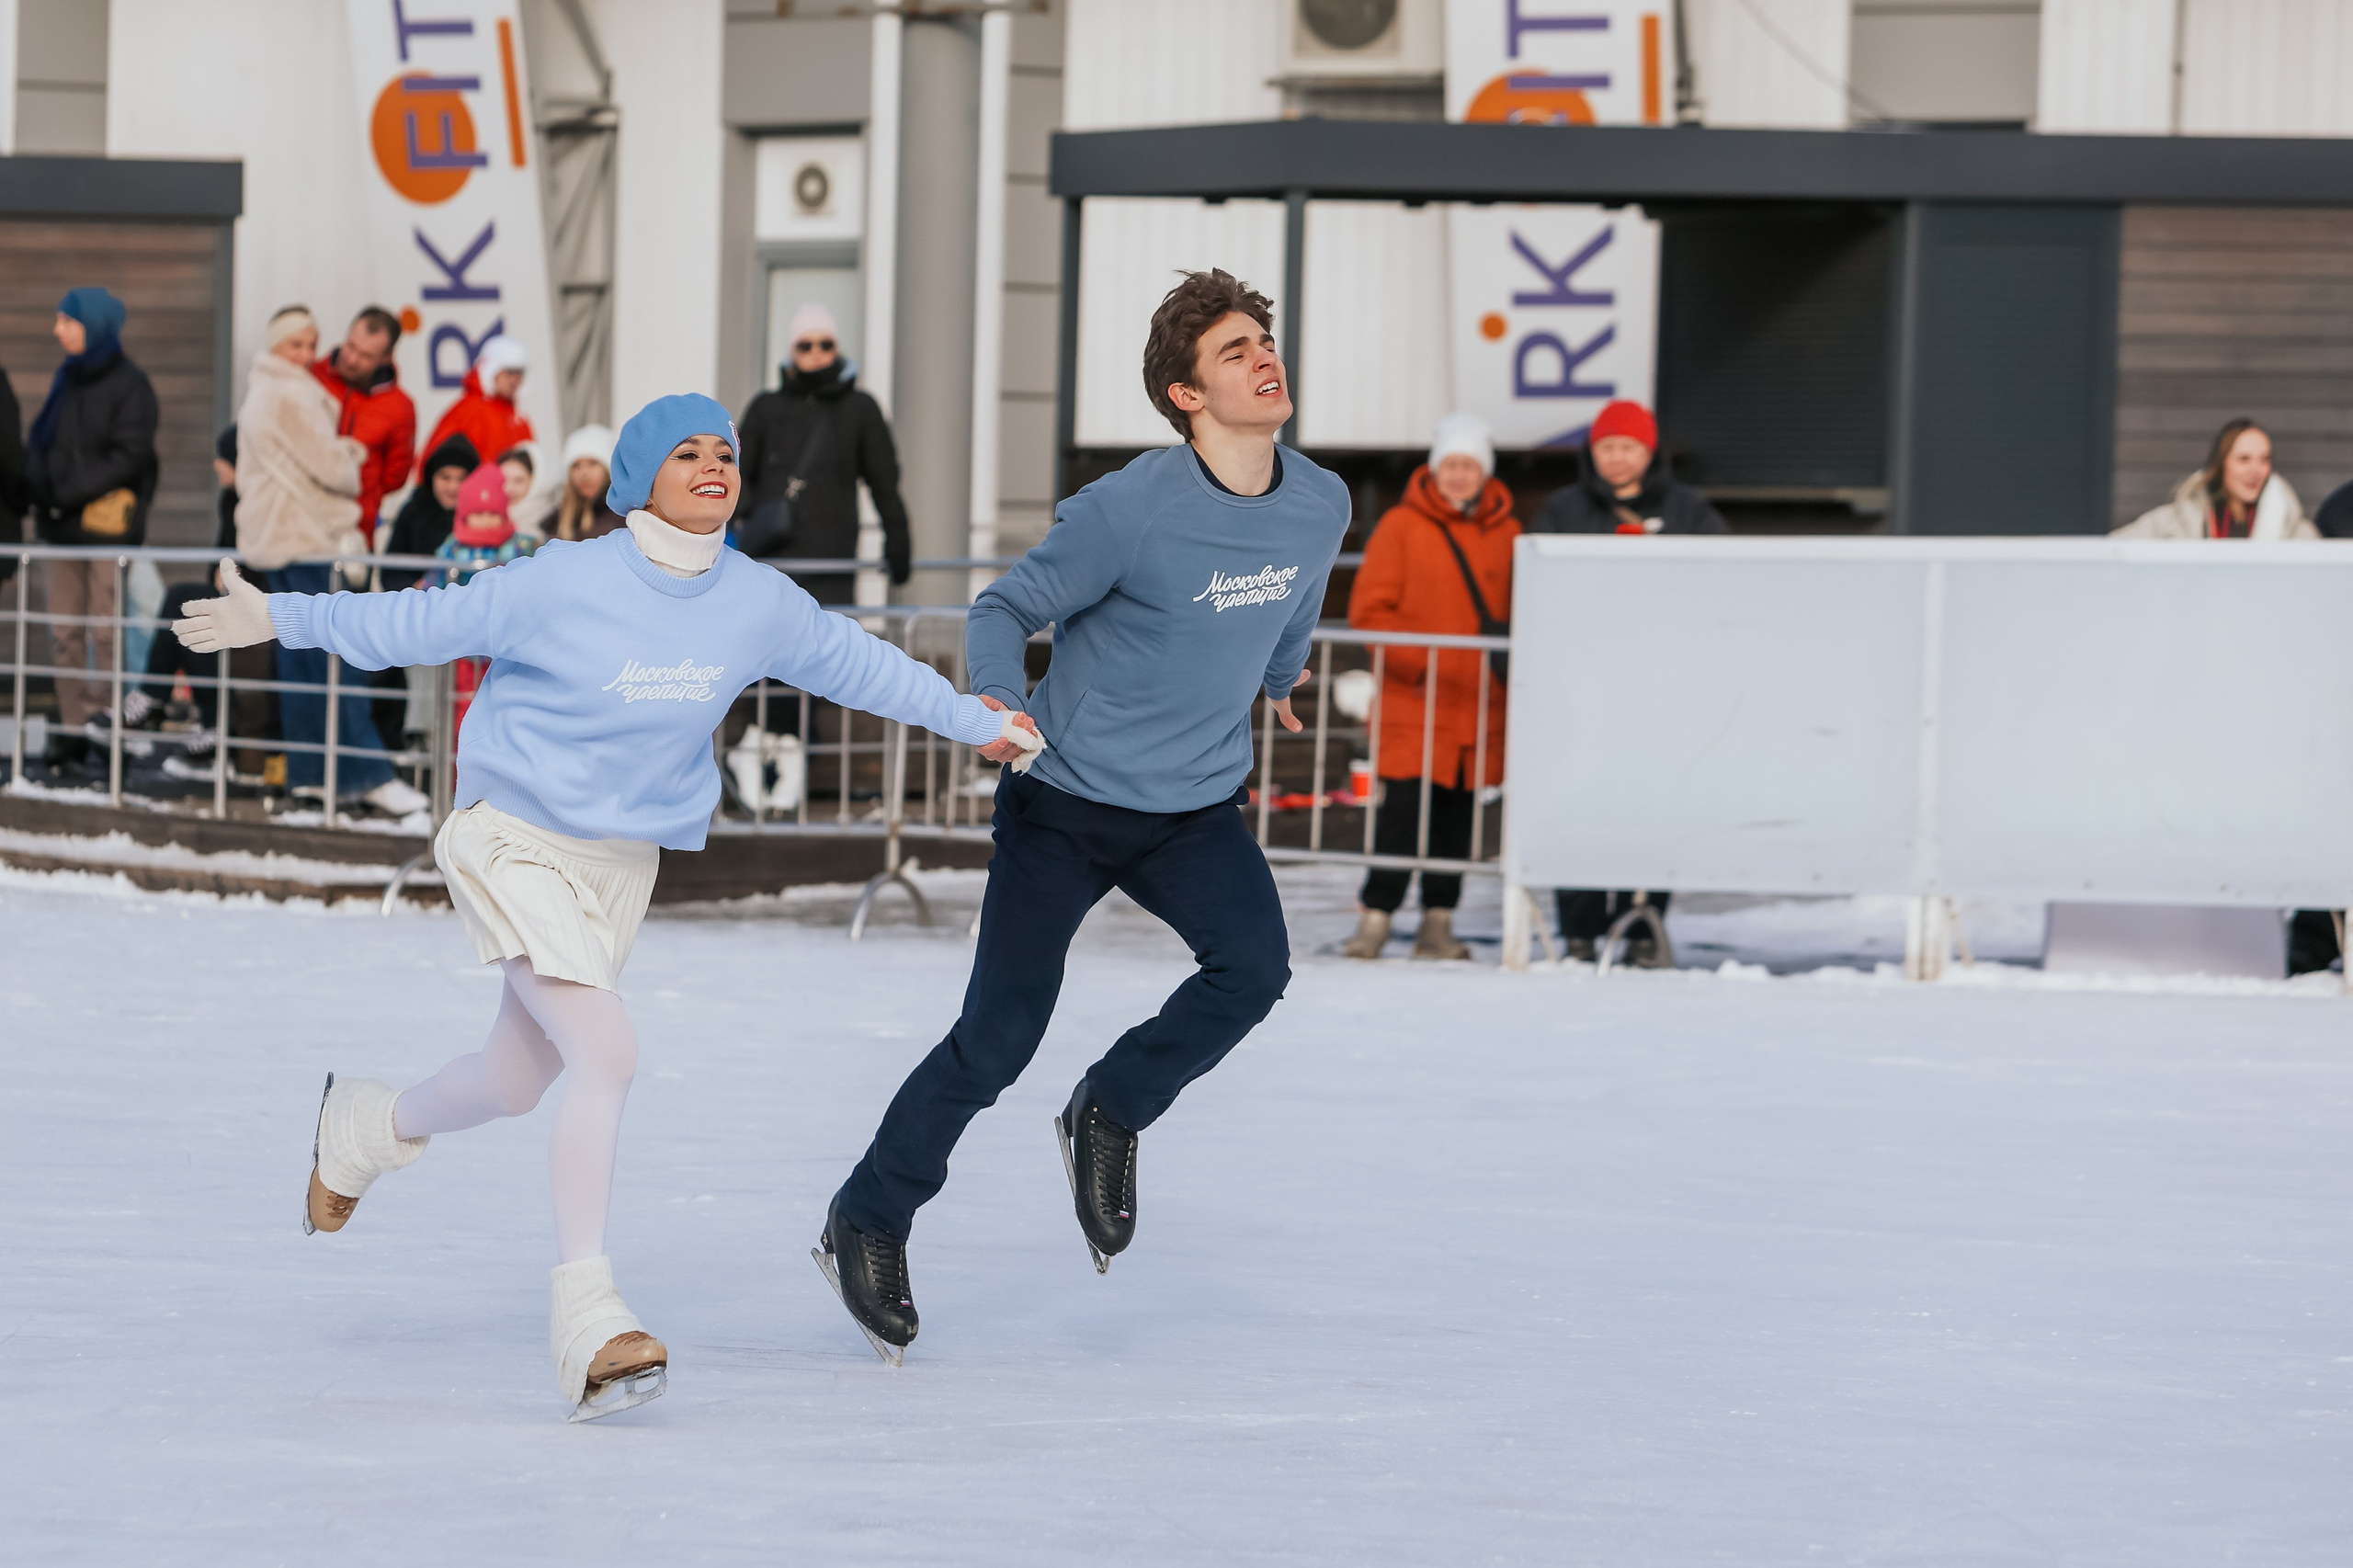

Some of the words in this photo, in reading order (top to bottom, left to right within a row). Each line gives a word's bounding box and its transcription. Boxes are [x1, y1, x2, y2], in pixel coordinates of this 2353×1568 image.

[388, 0, 489, 169] FIT
[1506, 0, 1611, 124] IT
[413, 219, 505, 390] RK
[1510, 223, 1617, 449] RK
[1193, 564, 1299, 602] Московское
[1209, 583, 1291, 613] чаепитие
[601, 658, 724, 691] Московское
[616, 681, 716, 704] чаепитие
